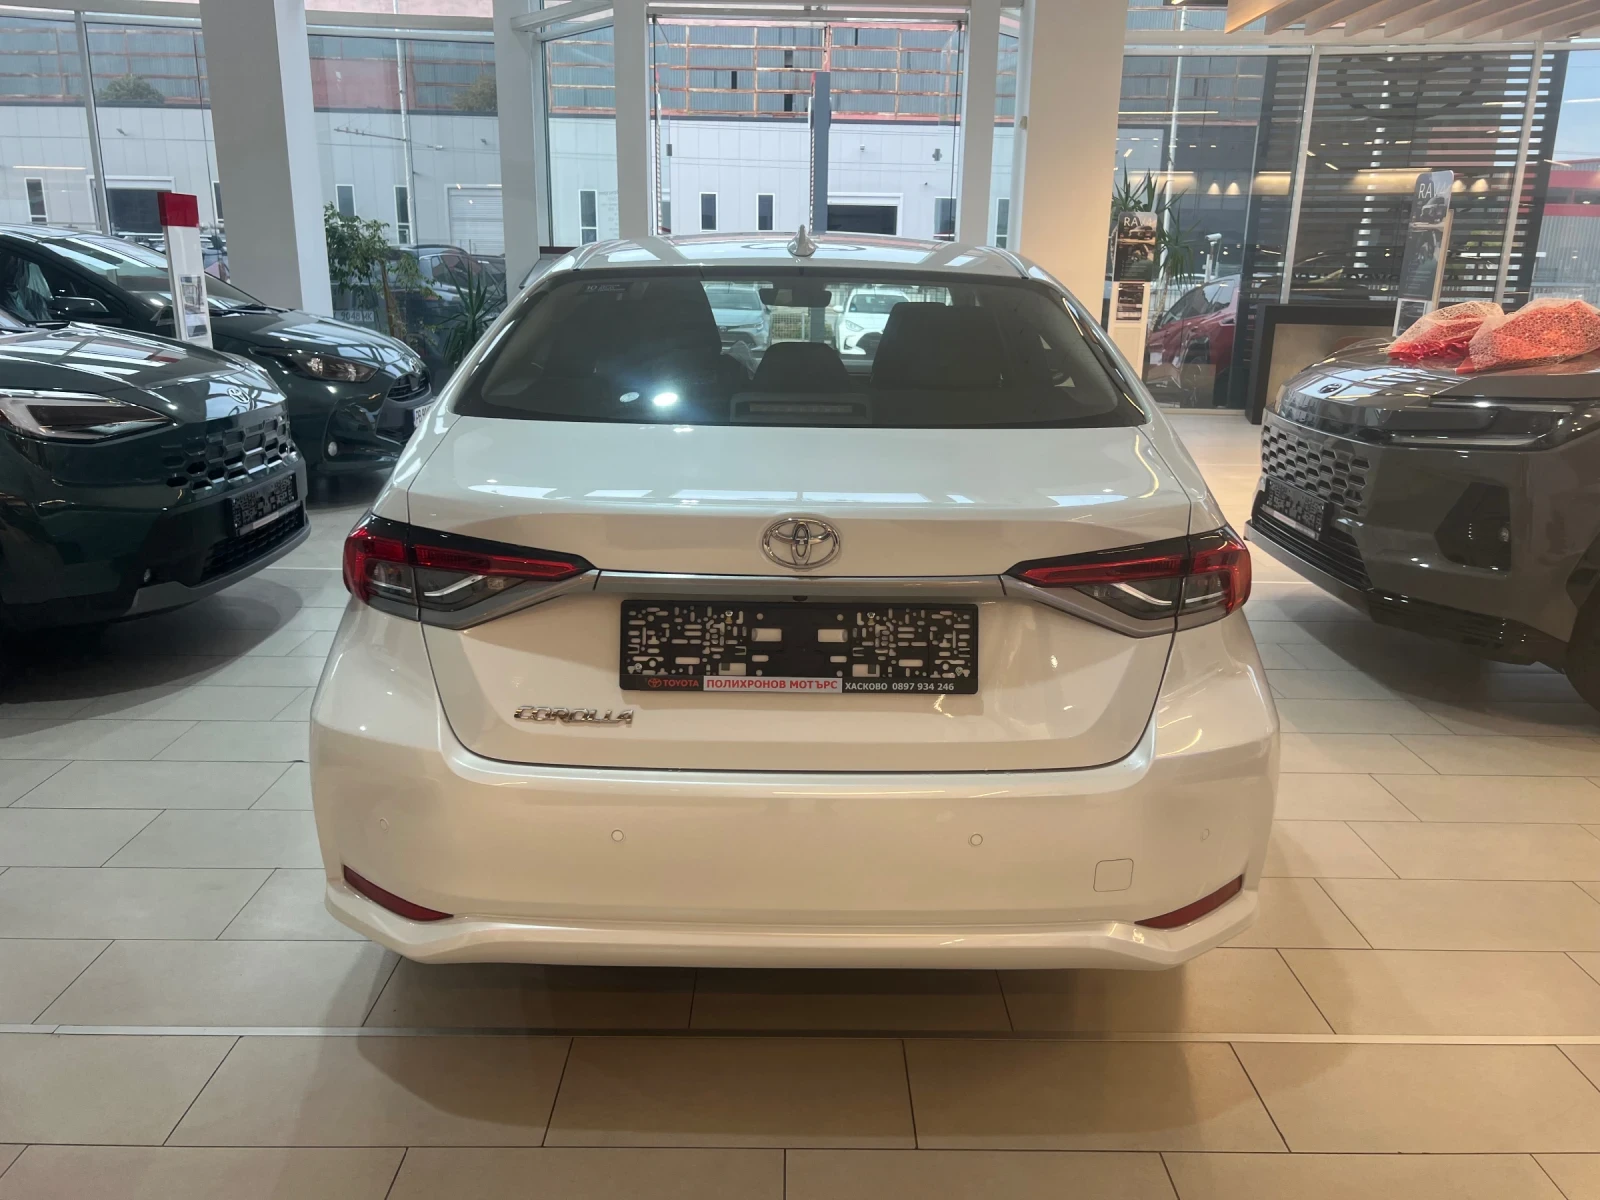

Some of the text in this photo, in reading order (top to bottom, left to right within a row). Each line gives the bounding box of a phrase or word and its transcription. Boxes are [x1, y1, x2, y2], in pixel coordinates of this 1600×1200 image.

[663, 679, 699, 687] TOYOTA
[706, 679, 838, 690] ПОЛИХРОНОВ МОТЪРС
[845, 682, 955, 691] ХАСКОВО 0897 934 246
[514, 705, 634, 725] COROLLA
